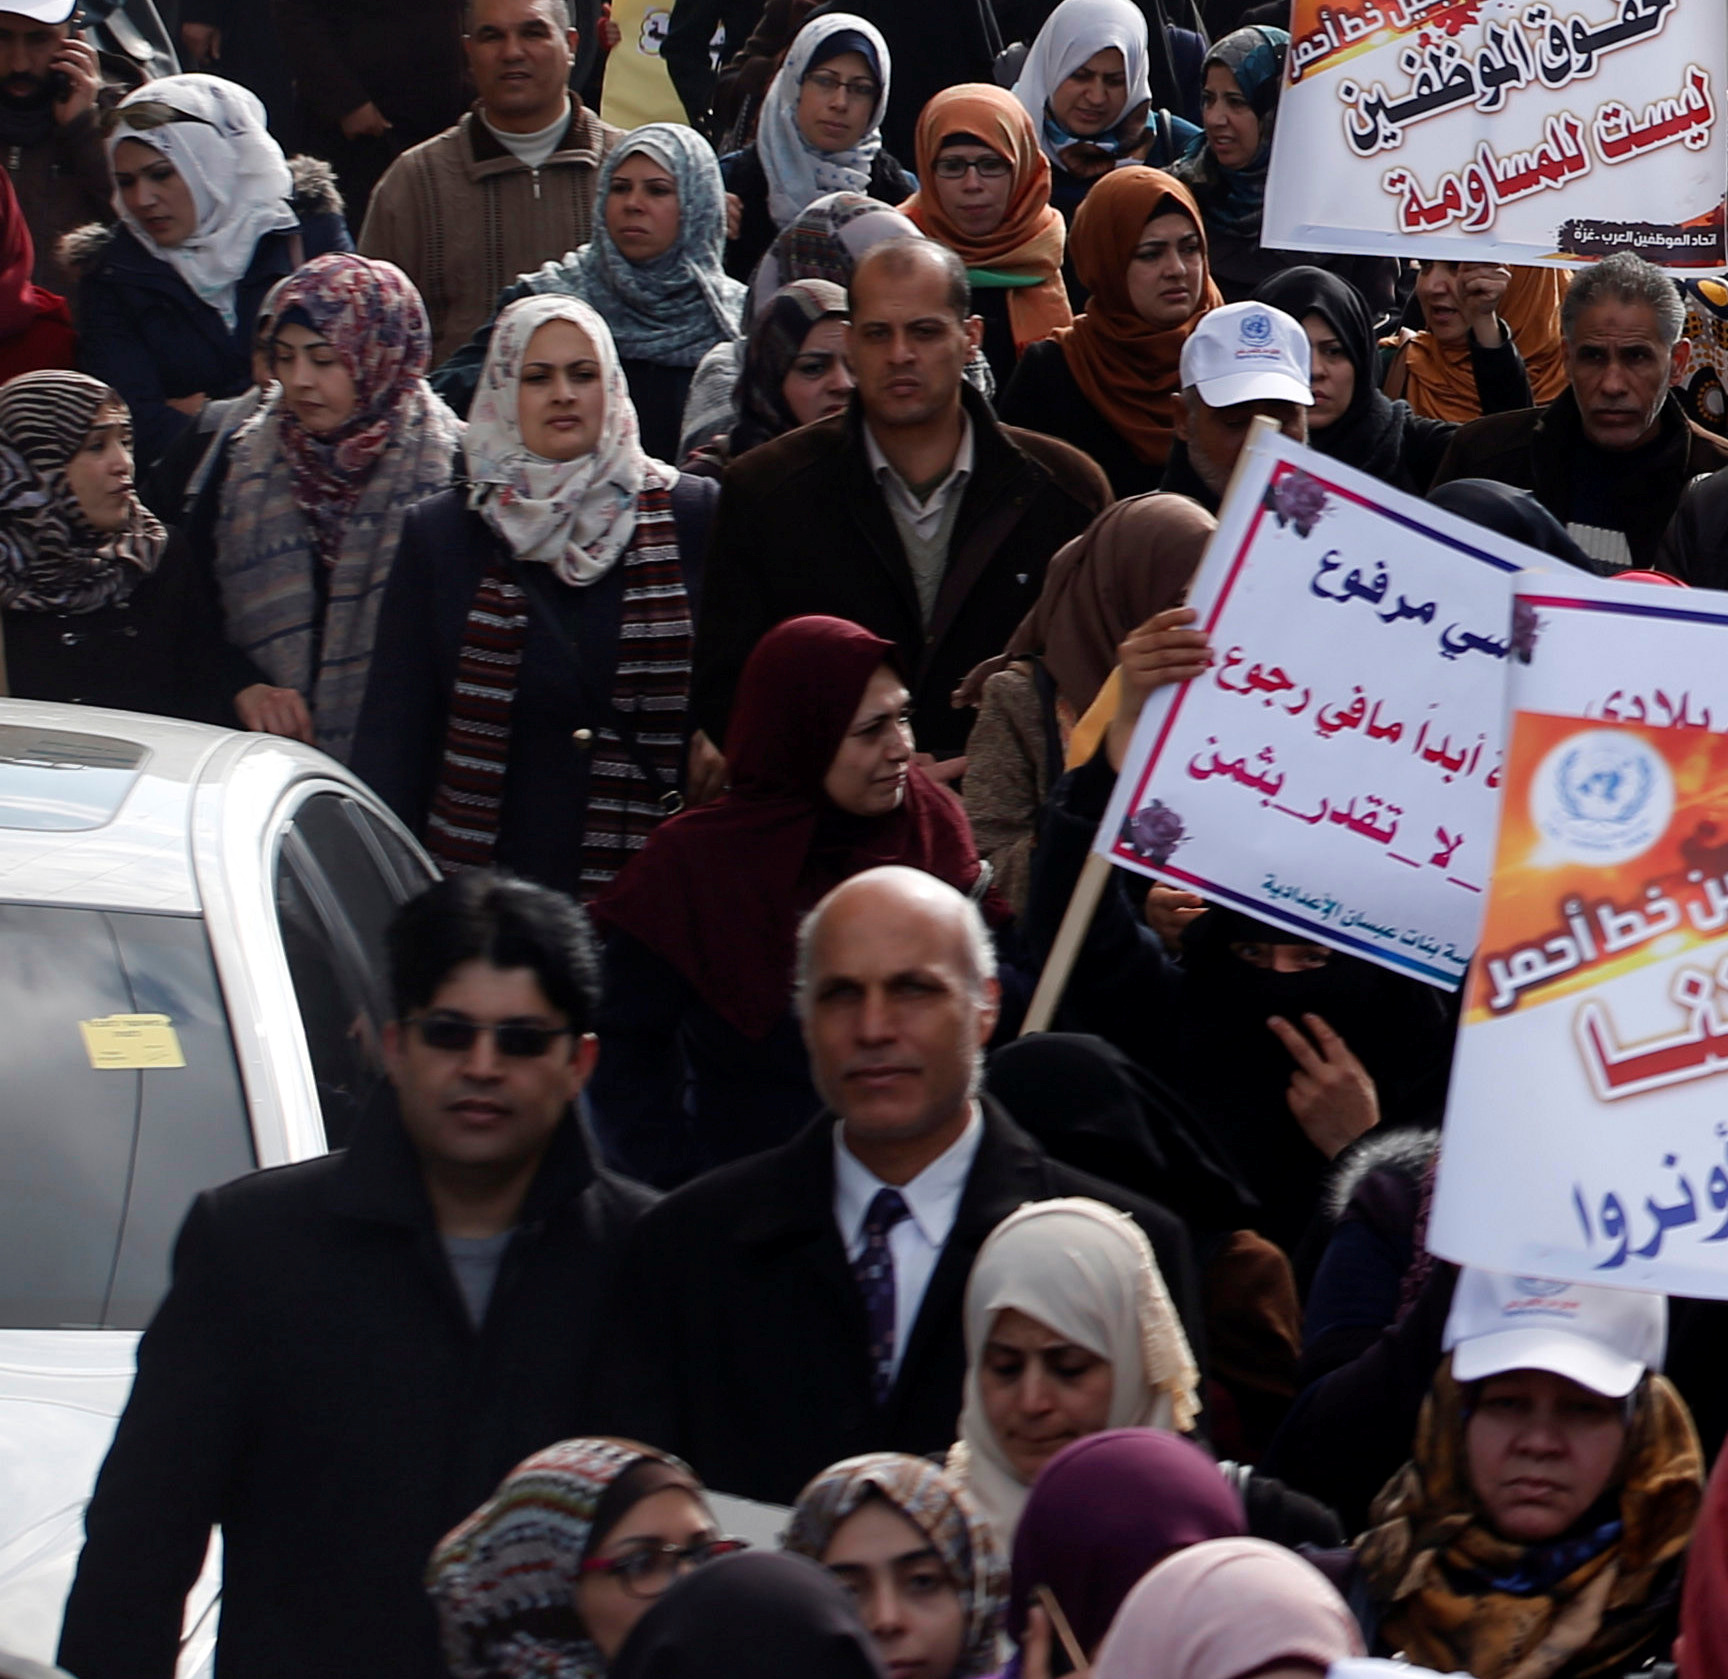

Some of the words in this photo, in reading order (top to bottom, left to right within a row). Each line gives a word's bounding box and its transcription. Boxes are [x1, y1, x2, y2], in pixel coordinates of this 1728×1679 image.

[1291, 17, 1339, 78] أحمر
[1341, 0, 1386, 44] خط
[1339, 23, 1534, 152] الموظفين
[1598, 69, 1713, 161] ليست
[1386, 116, 1590, 229] للمساومة
[1602, 231, 1633, 245] العرب
[1633, 231, 1691, 248] الموظفين
[1691, 233, 1718, 247] اتحاد
[1309, 549, 1438, 624] مرفوع
[1215, 646, 1311, 716] رجوع
[1261, 872, 1343, 922] الإعدادية
[1590, 882, 1682, 958] خط
[1400, 927, 1441, 959] بنات
[1486, 902, 1596, 1014] أحمر
